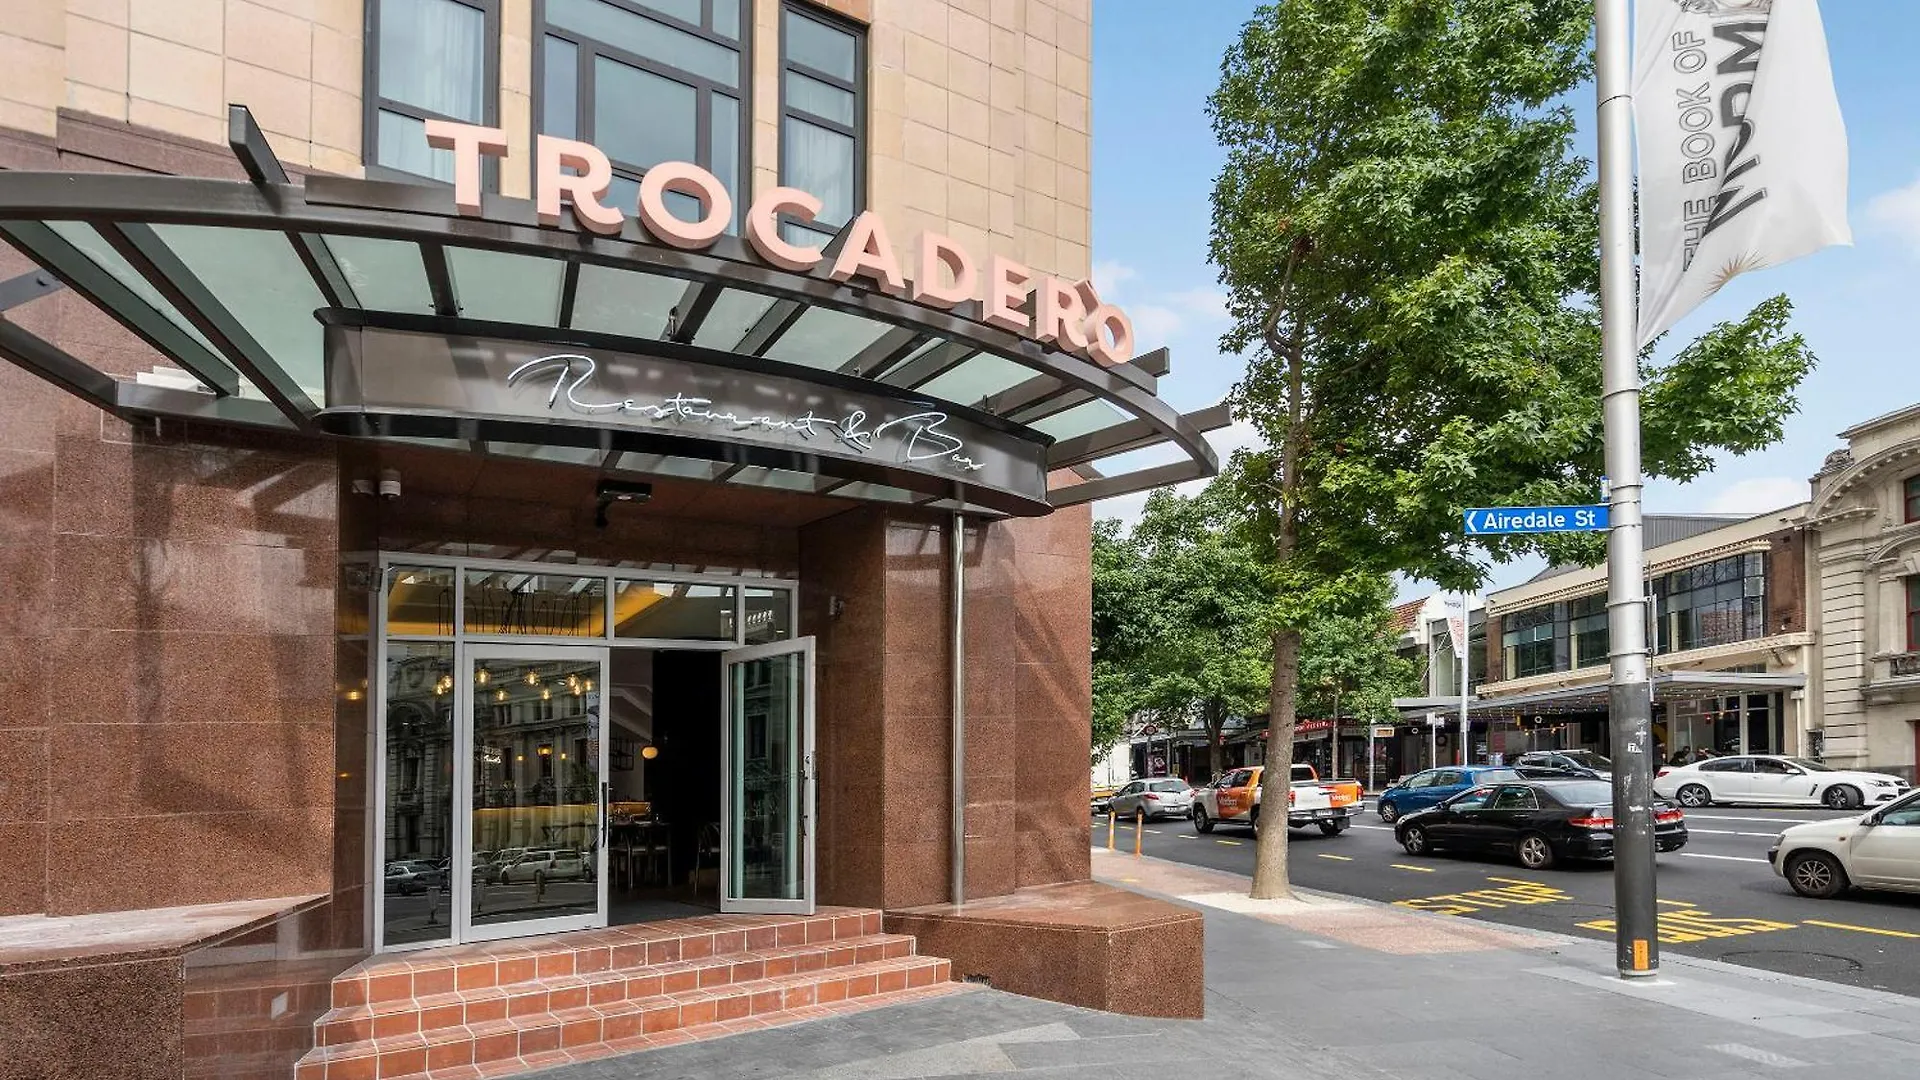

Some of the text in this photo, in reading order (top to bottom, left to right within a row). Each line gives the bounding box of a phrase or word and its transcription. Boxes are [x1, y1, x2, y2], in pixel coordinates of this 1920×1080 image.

[1672, 31, 1707, 74] OF
[1676, 81, 1717, 184] BOOK
[508, 354, 986, 471] Restaurant & Bar
[1483, 509, 1596, 530] Airedale St
